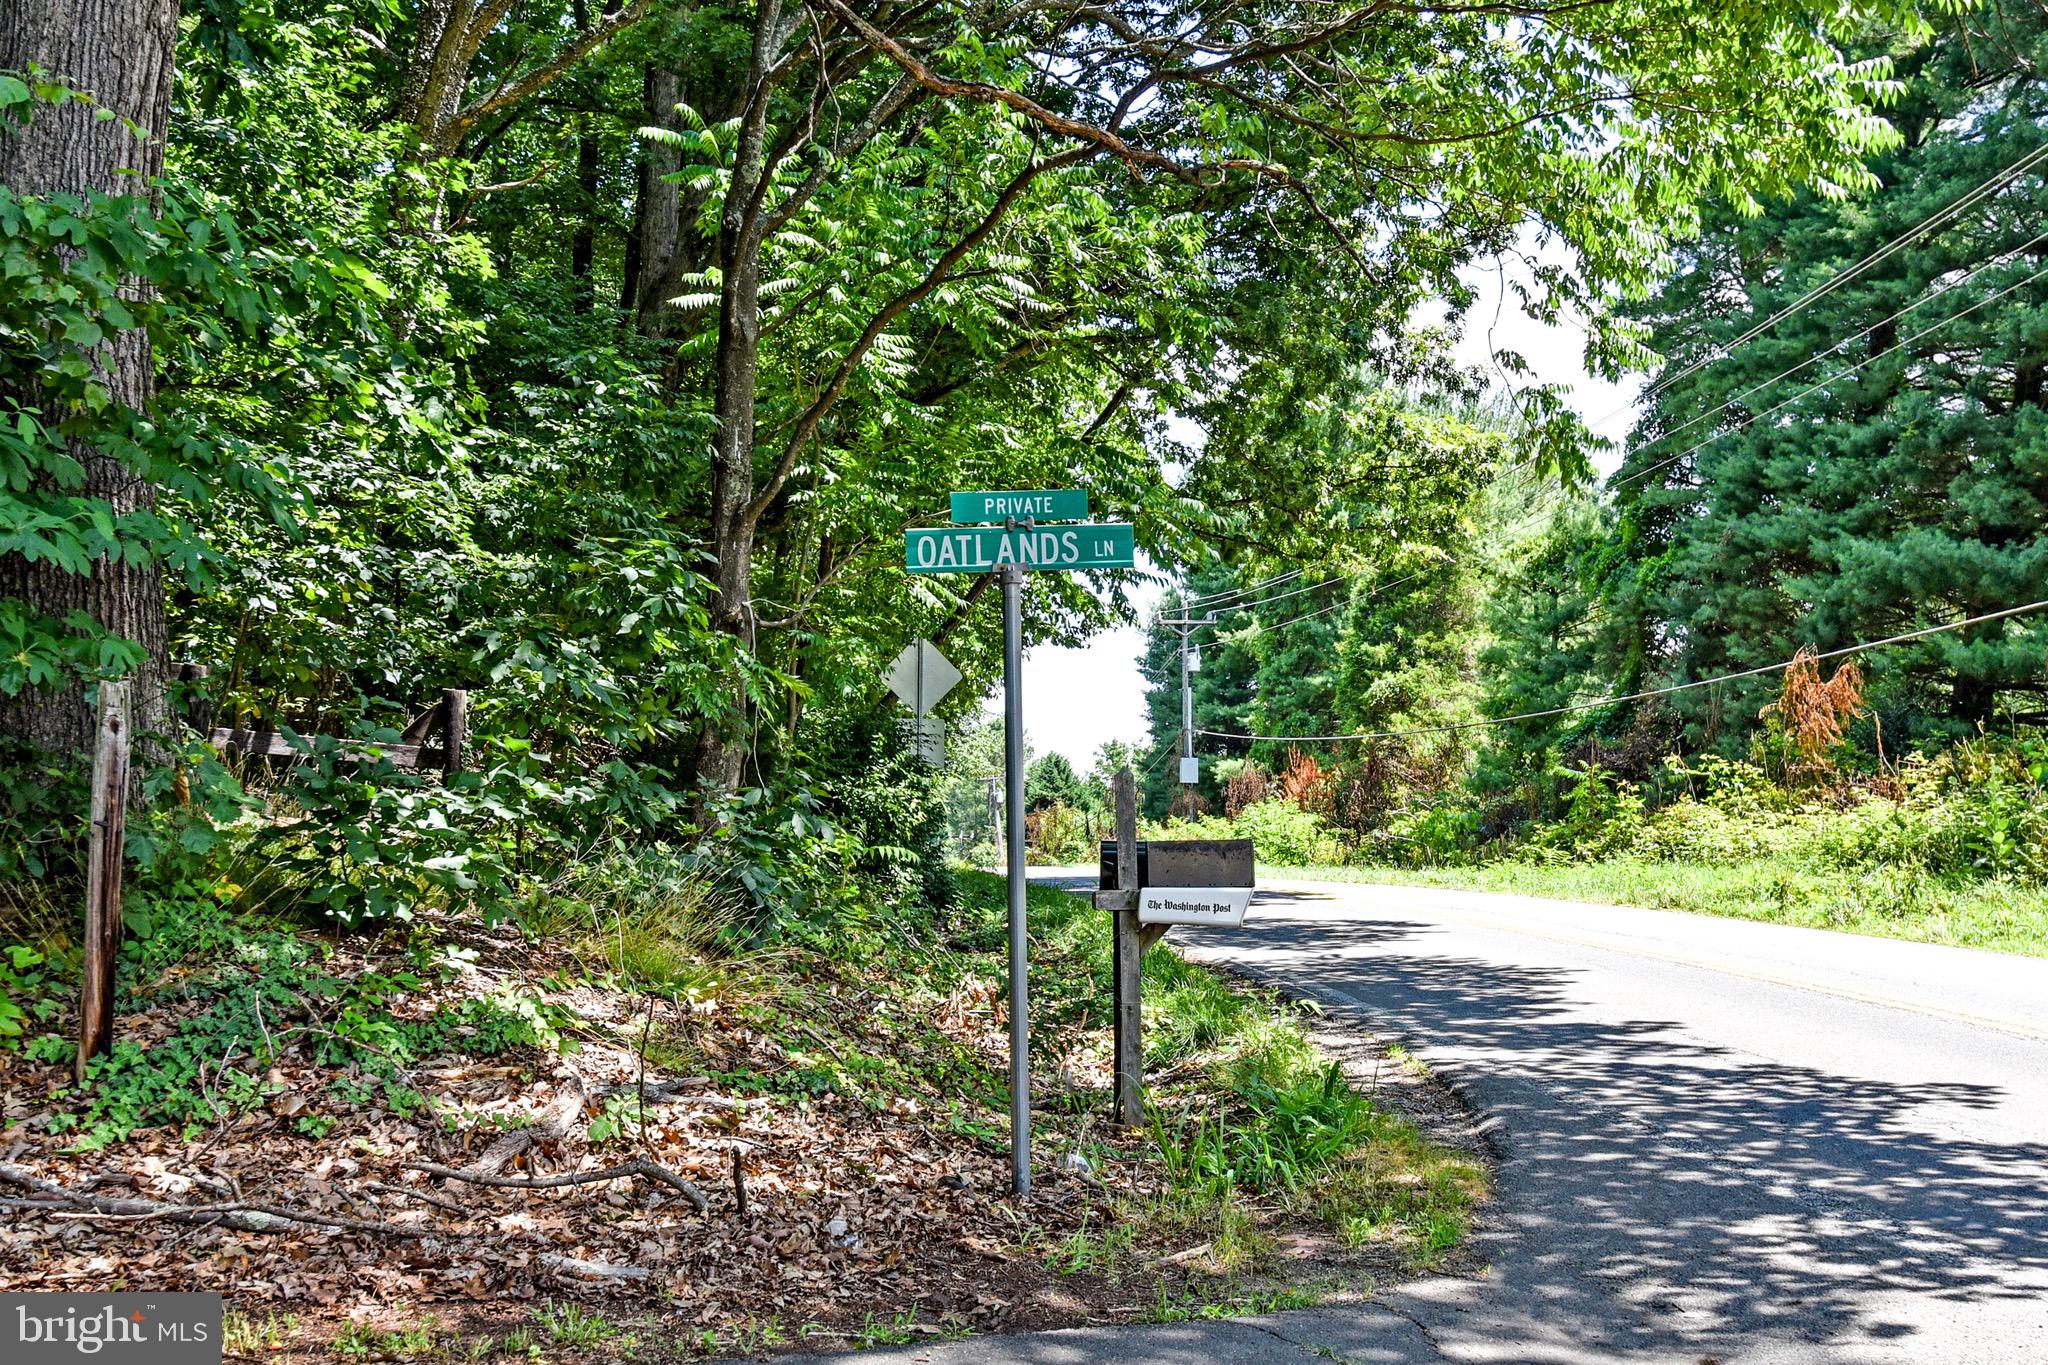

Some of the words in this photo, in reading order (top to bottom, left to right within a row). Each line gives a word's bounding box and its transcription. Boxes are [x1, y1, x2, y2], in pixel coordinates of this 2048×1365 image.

[985, 497, 1053, 514] PRIVATE
[917, 531, 1080, 567] OATLANDS
[1094, 540, 1114, 557] LN
[1147, 899, 1163, 910] The
[1164, 899, 1211, 914] Washington
[1213, 903, 1231, 914] Post
